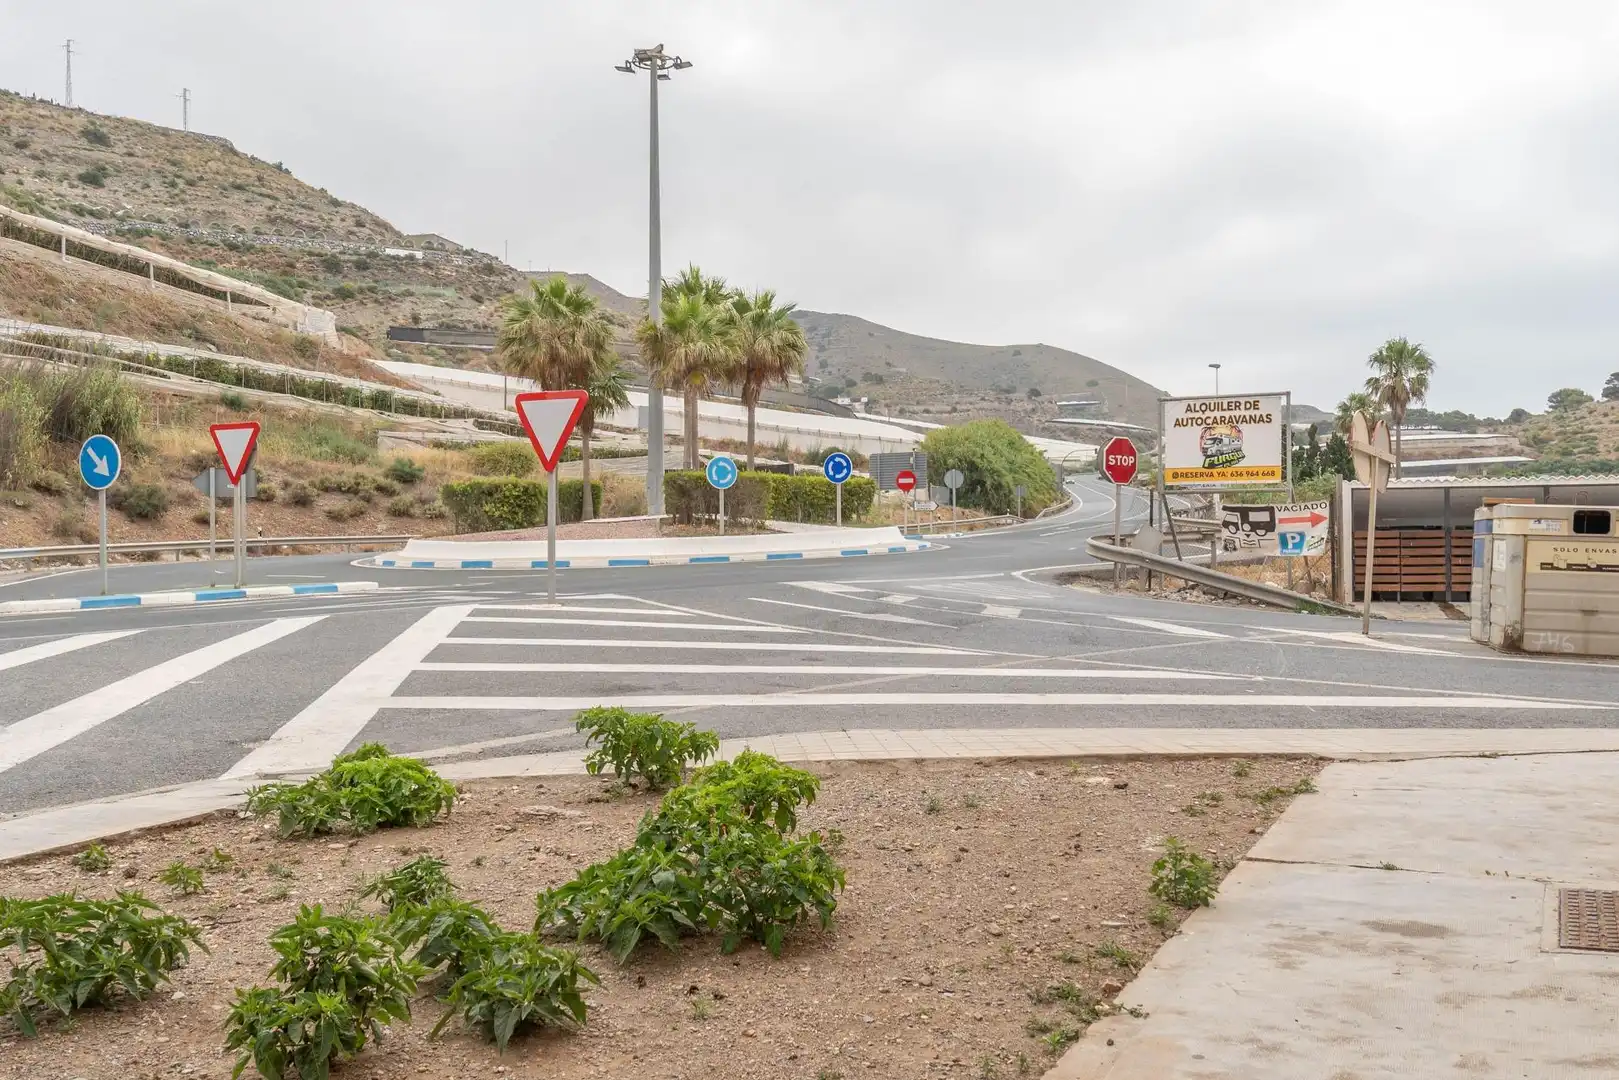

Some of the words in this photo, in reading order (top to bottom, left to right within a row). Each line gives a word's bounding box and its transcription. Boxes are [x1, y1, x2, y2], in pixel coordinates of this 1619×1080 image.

[1185, 401, 1242, 414] ALQUILER
[1244, 400, 1260, 411] DE
[1173, 413, 1273, 428] AUTOCARAVANAS
[1108, 455, 1135, 467] STOP
[1179, 471, 1214, 479] RESERVA
[1230, 470, 1244, 478] 636
[1261, 469, 1276, 477] 668
[1275, 501, 1327, 512] VACIADO
